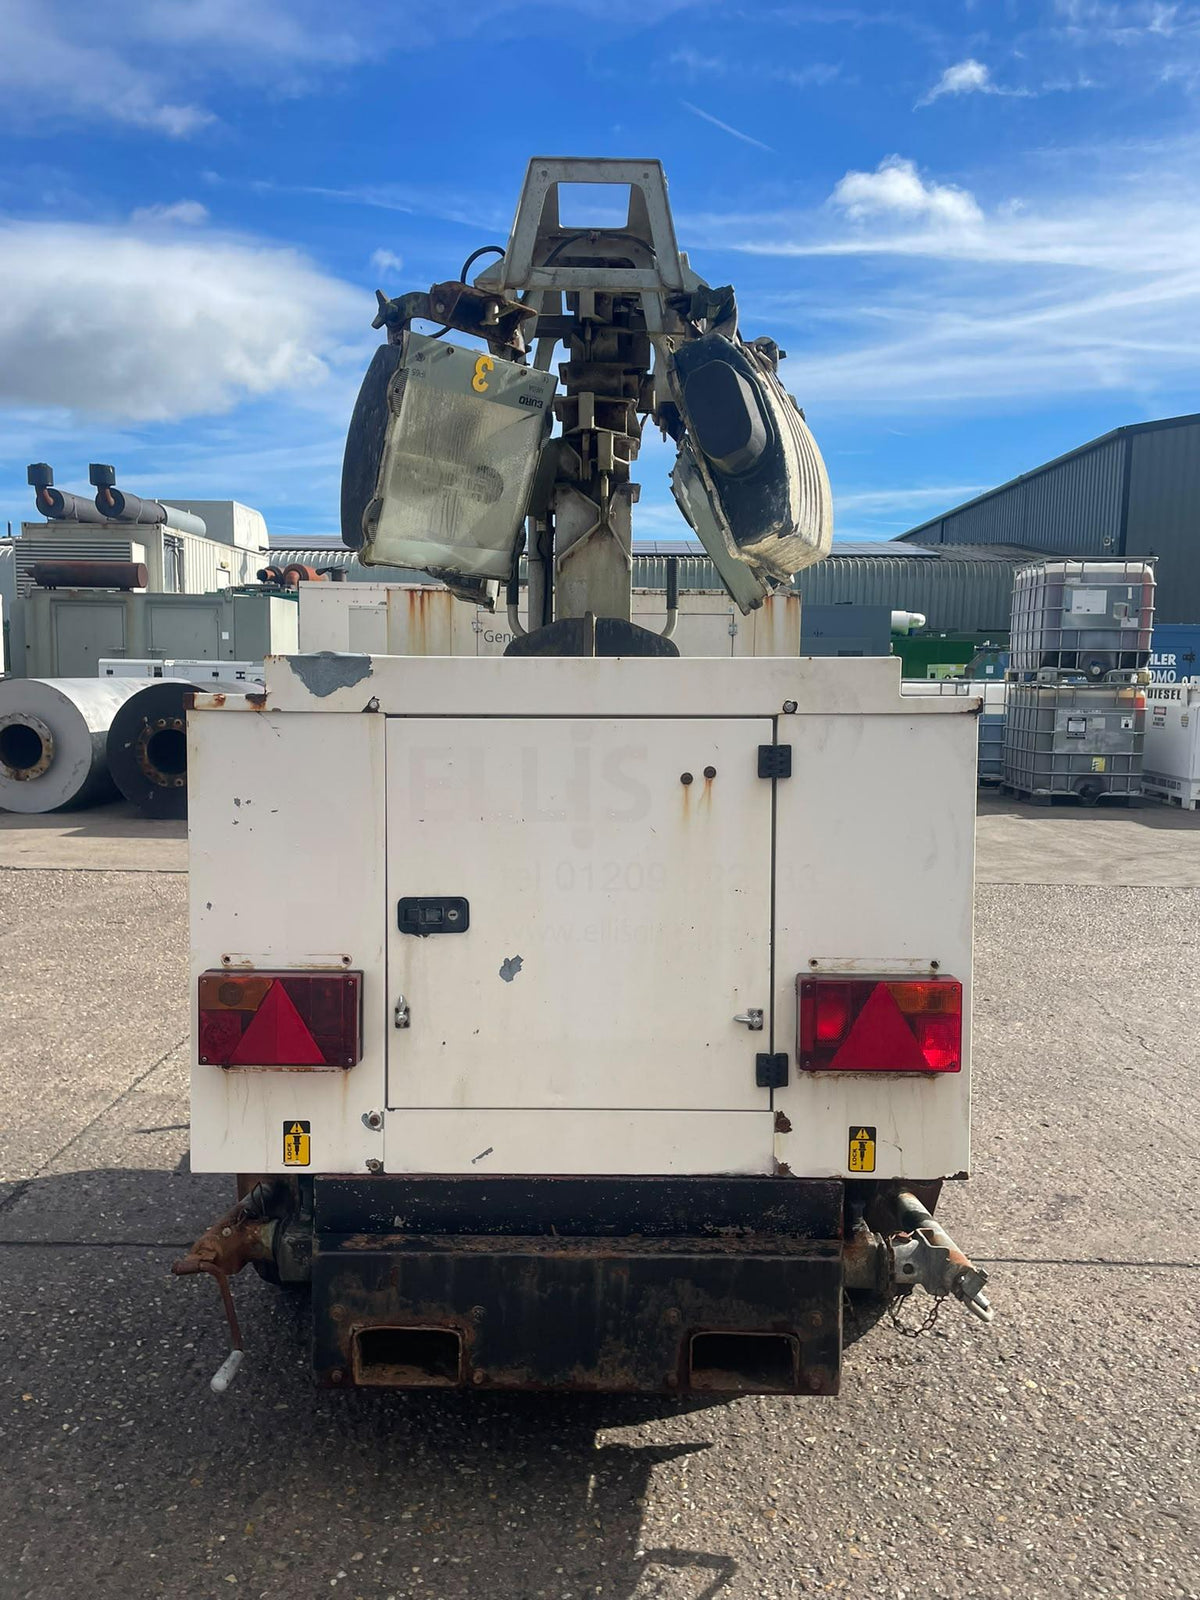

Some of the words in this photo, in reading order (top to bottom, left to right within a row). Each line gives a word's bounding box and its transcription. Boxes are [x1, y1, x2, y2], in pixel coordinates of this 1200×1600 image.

[472, 355, 494, 393] 3
[518, 396, 544, 409] EURO
[1147, 688, 1182, 701] DIESEL
[555, 860, 668, 892] 01209
